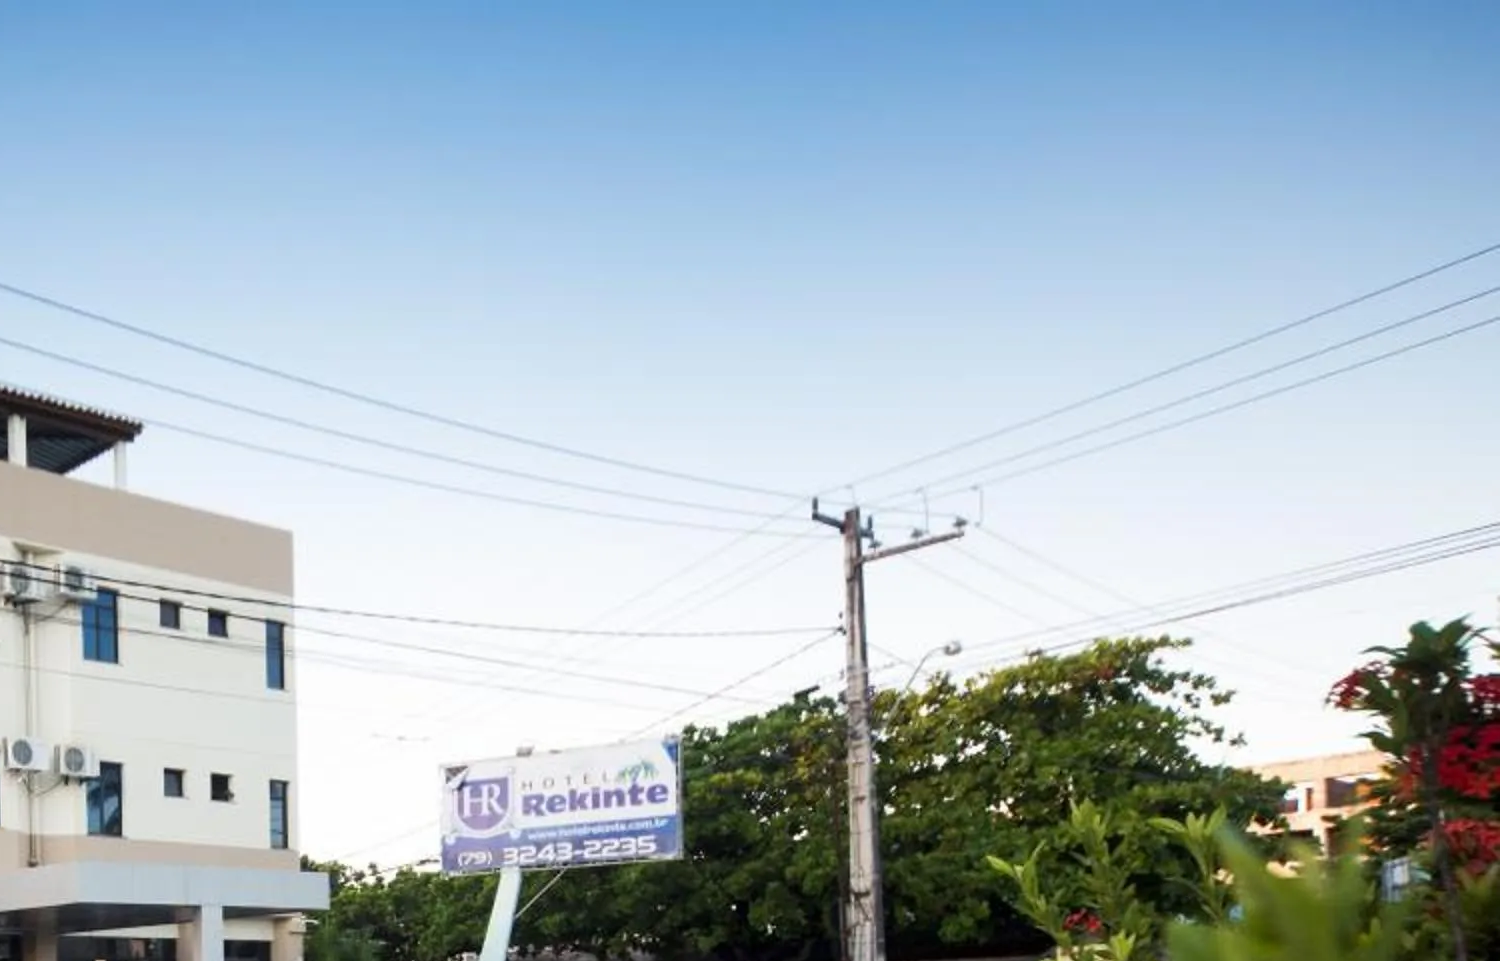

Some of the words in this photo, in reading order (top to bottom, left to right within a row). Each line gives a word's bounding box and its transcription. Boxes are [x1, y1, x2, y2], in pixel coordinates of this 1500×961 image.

[521, 772, 610, 791] HOTEL
[462, 782, 504, 818] HR
[521, 783, 670, 817] Rekinte
[457, 850, 493, 867] (79)
[502, 835, 658, 866] 3243-2235
